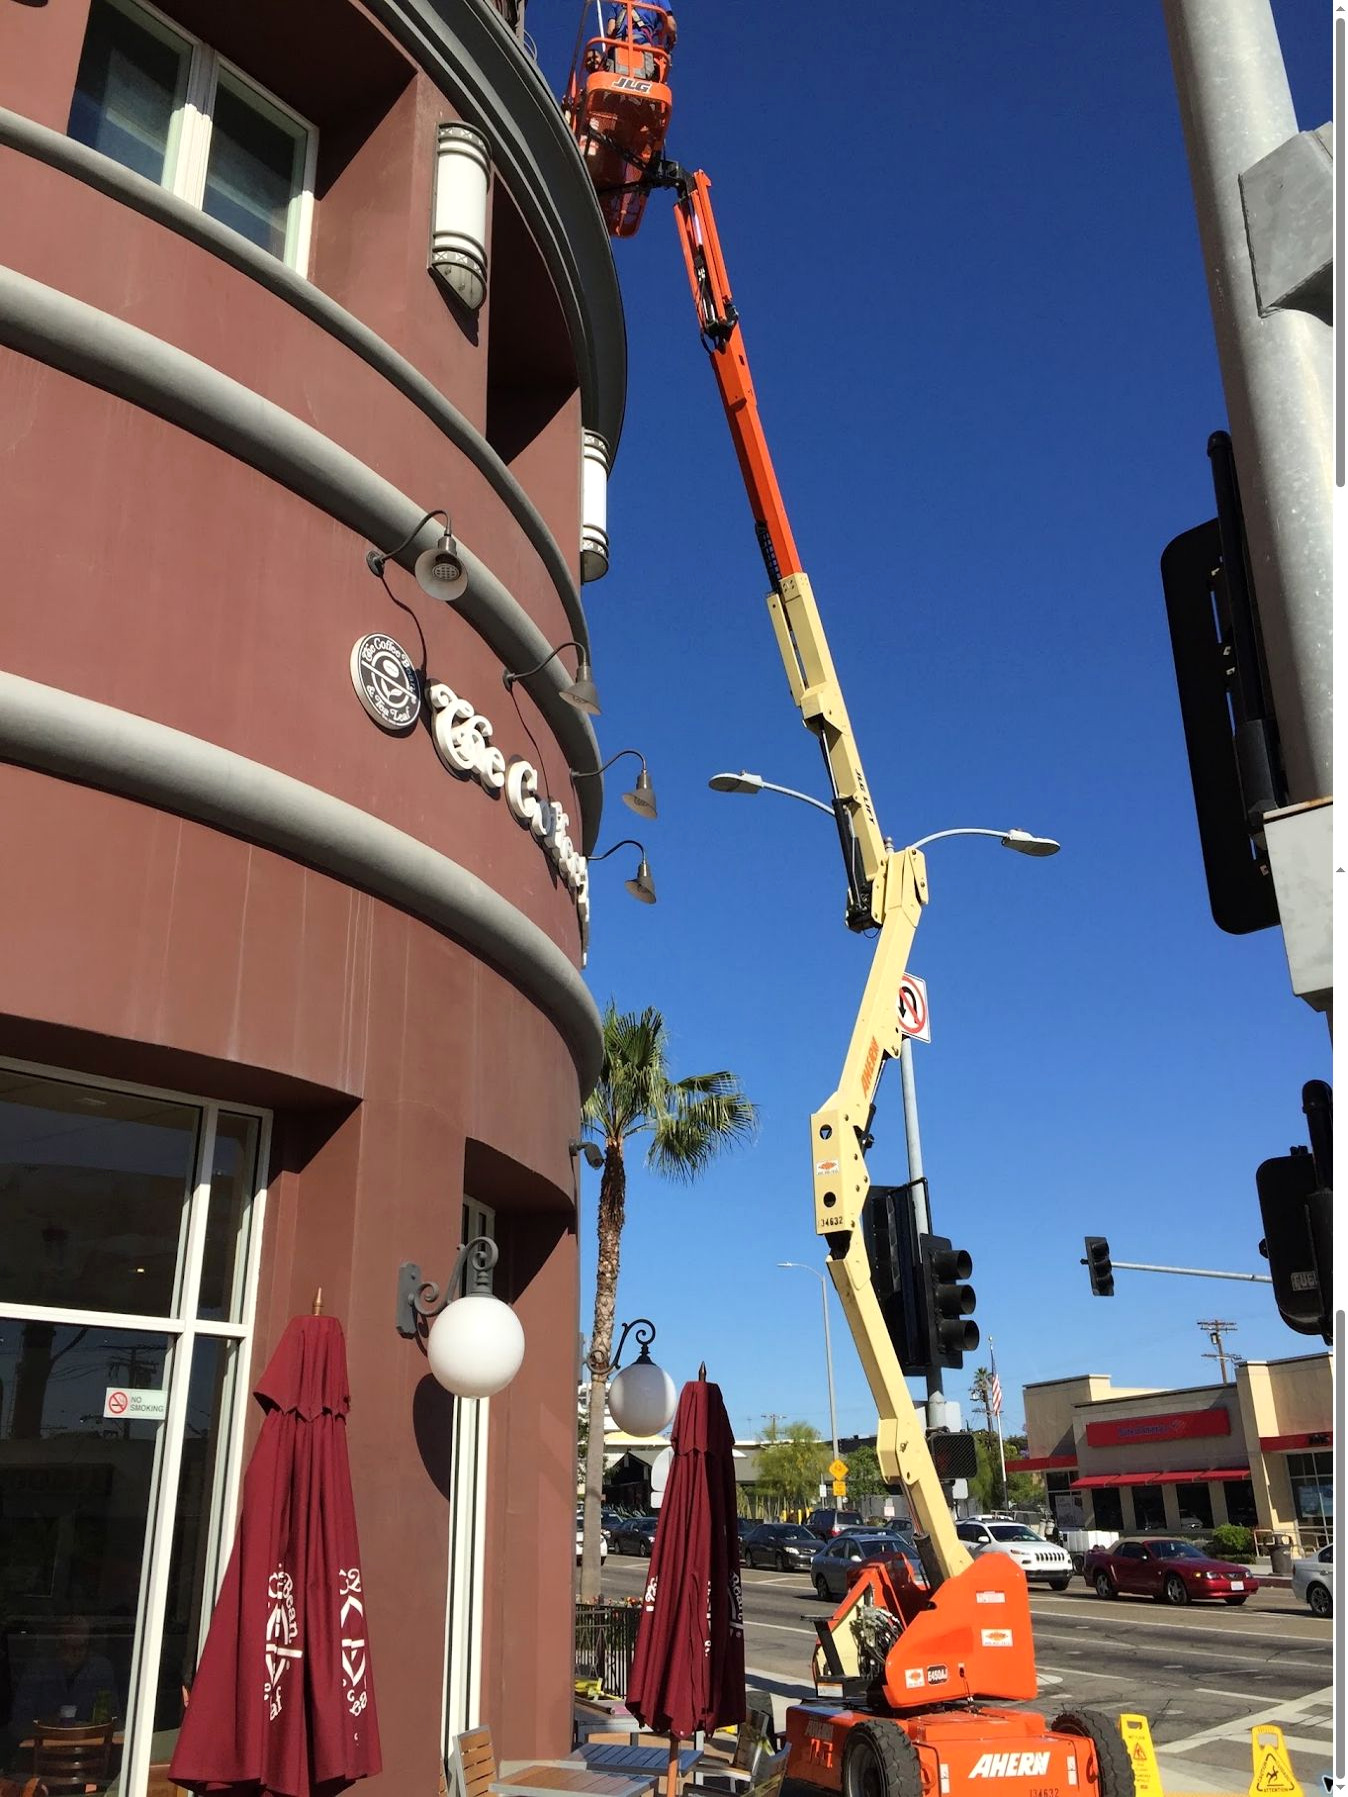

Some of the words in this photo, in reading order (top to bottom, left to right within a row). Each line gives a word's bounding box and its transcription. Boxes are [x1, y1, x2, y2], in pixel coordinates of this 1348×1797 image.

[612, 77, 652, 94] JLG
[361, 642, 377, 661] The
[373, 637, 401, 659] Coffee
[366, 684, 376, 698] &
[374, 694, 390, 716] Tea
[430, 683, 506, 788] The
[861, 1035, 880, 1100] AHERN
[129, 1403, 165, 1413] SMOKING
[130, 1396, 143, 1404] NO
[968, 1751, 1051, 1779] AHERN
